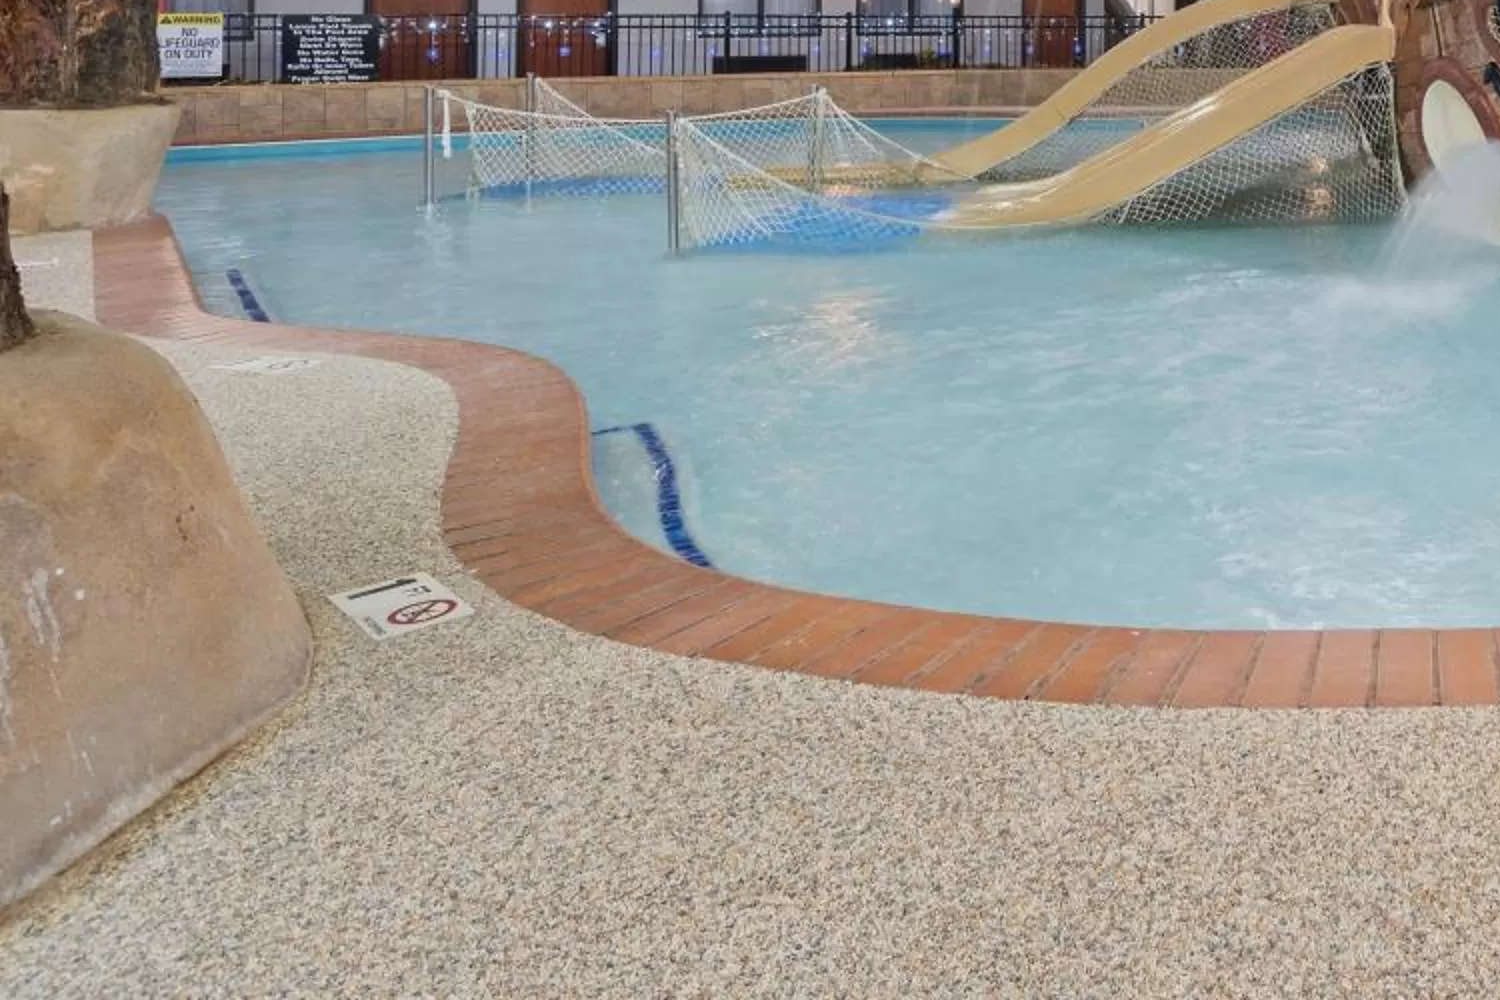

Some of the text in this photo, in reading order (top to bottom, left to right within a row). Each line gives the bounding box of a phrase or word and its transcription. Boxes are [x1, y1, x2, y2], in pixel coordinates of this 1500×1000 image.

[172, 15, 220, 24] WARNING
[181, 27, 198, 37] NO
[164, 49, 213, 59] ON DUTY
